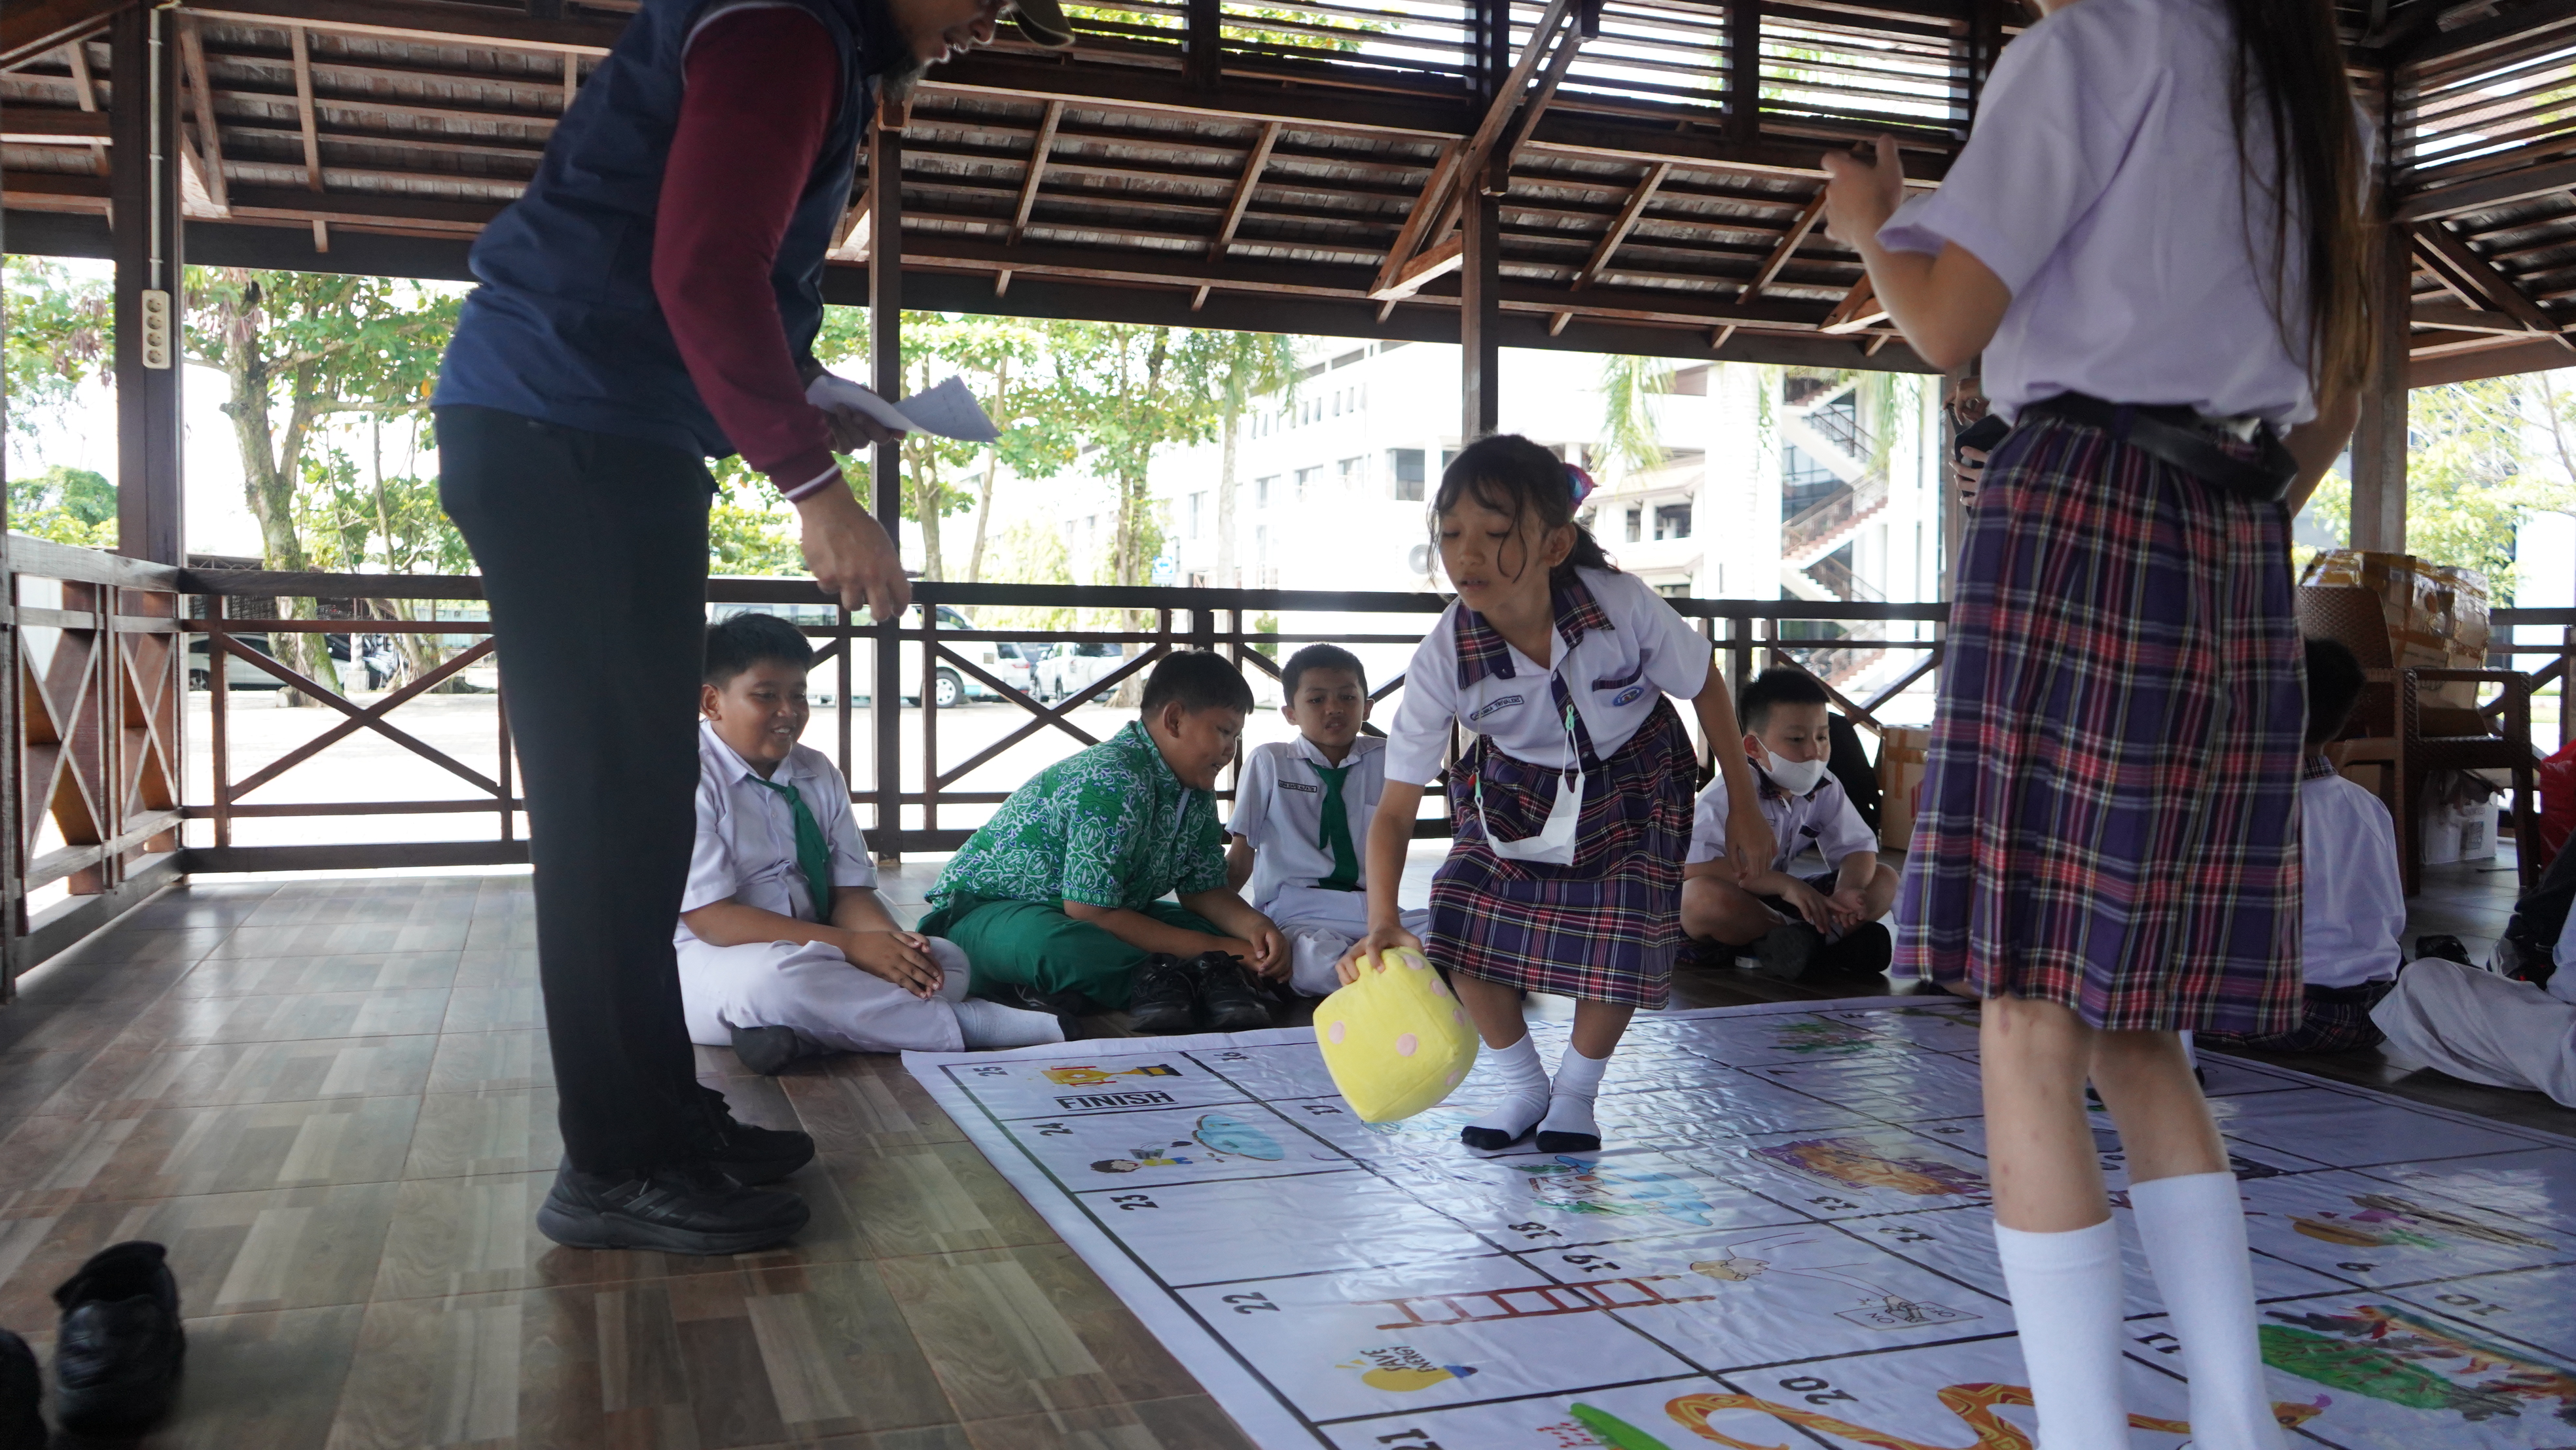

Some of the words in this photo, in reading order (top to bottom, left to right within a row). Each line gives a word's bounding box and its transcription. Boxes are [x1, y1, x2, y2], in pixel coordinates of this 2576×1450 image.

[973, 1067, 1009, 1077] 25
[1055, 1091, 1176, 1109] FINISH
[1301, 1105, 1344, 1115] 17
[1033, 1123, 1073, 1137] 24
[1109, 1194, 1160, 1211] 23
[1221, 1292, 1281, 1315] 22
[2435, 1294, 2512, 1316] 10
[1865, 1312, 1895, 1324] ON
[1359, 1349, 1412, 1372] SAVE
[1388, 1345, 1439, 1373] ENERGY
[1779, 1376, 1859, 1405] 20
